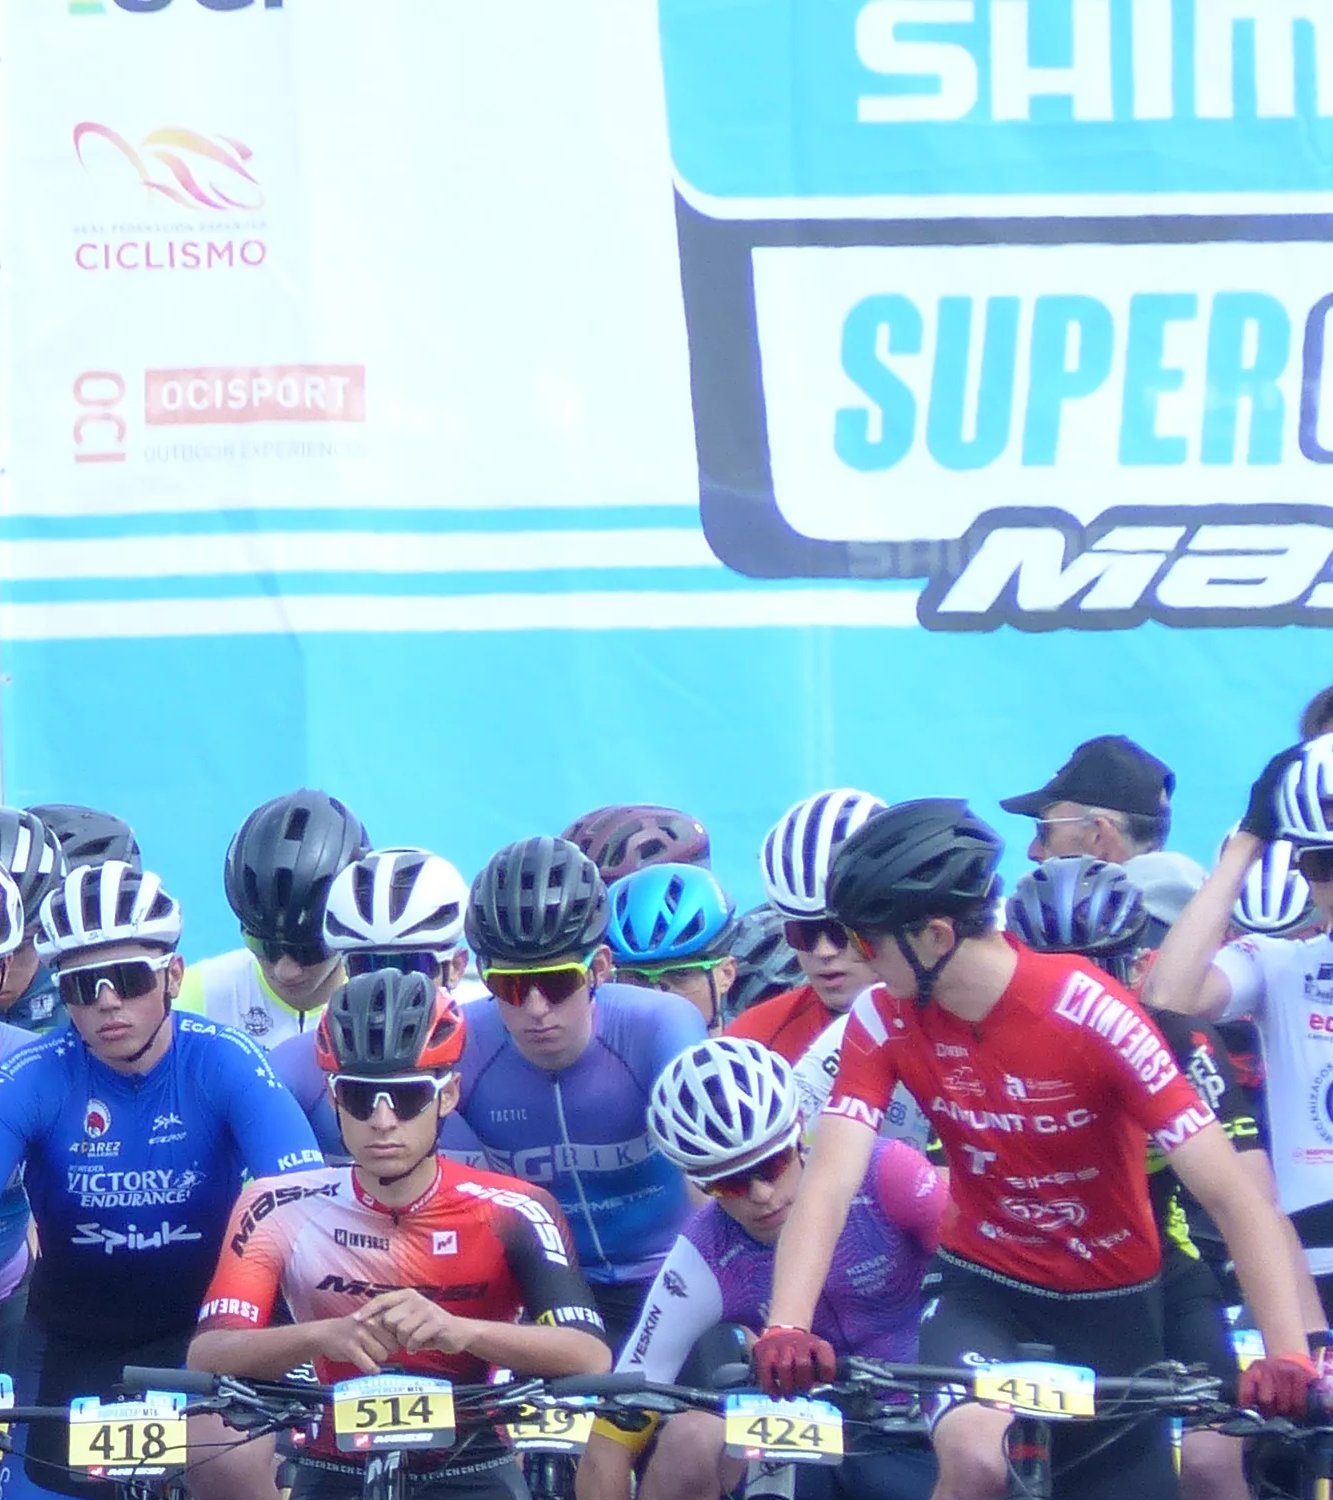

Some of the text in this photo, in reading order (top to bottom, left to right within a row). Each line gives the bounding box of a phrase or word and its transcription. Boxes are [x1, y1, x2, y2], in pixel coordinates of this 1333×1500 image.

[73, 239, 269, 272] CICLISMO
[161, 376, 351, 411] OCISPORT
[72, 369, 128, 466] OCI
[489, 1109, 529, 1123] TACTIC
[931, 1096, 1098, 1134] AMUNT C.C.
[67, 1169, 174, 1193] VICTORY
[630, 1304, 663, 1365] VESKIN
[997, 1378, 1068, 1411] 411
[355, 1395, 434, 1429] 514
[89, 1422, 168, 1461] 418
[747, 1416, 823, 1447] 424
